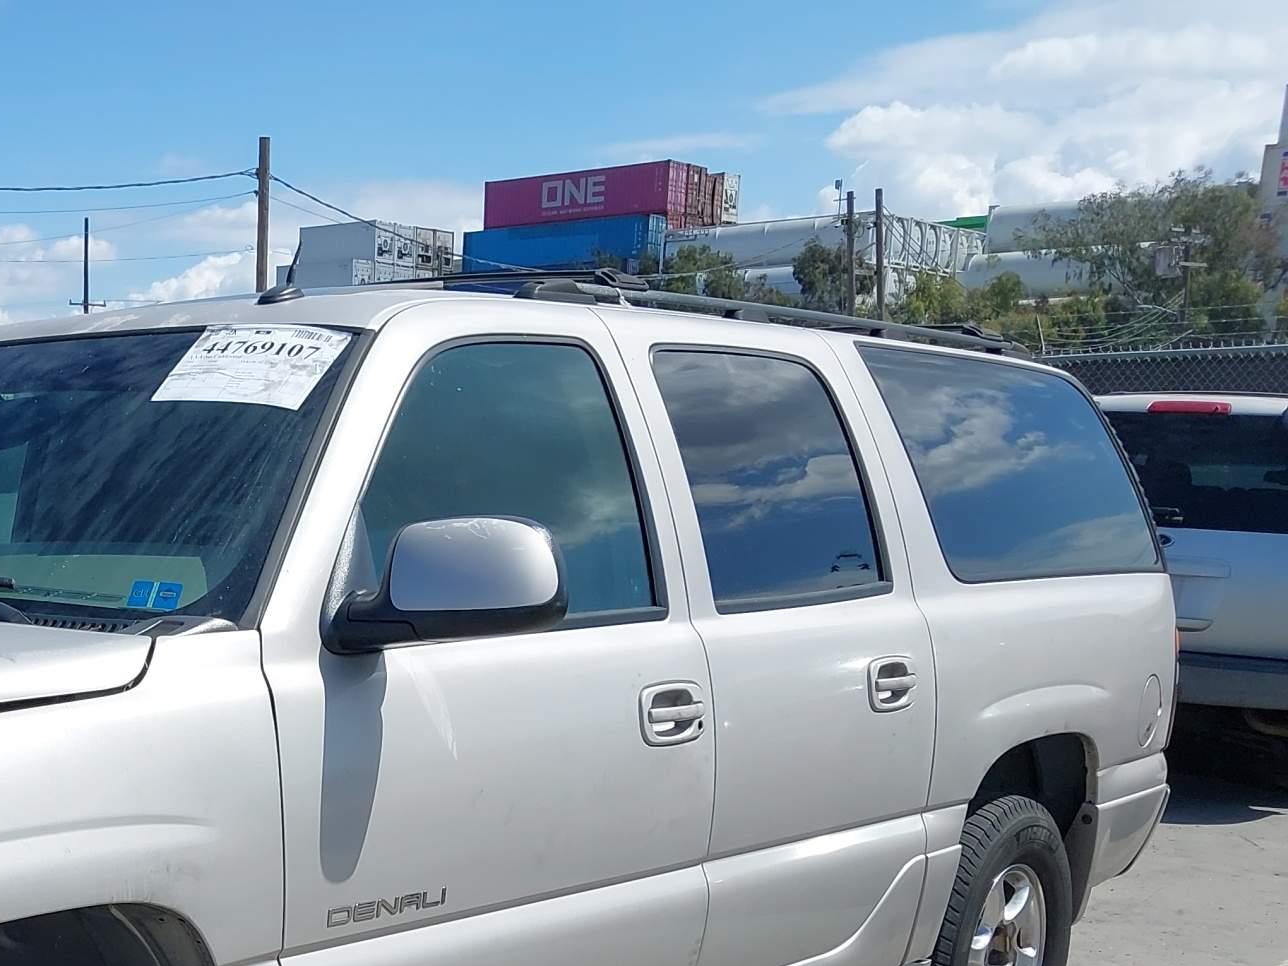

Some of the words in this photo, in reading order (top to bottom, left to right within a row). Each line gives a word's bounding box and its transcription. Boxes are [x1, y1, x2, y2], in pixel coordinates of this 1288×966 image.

[542, 176, 605, 208] ONE
[203, 341, 320, 359] 44769107
[327, 887, 446, 927] DENALI
